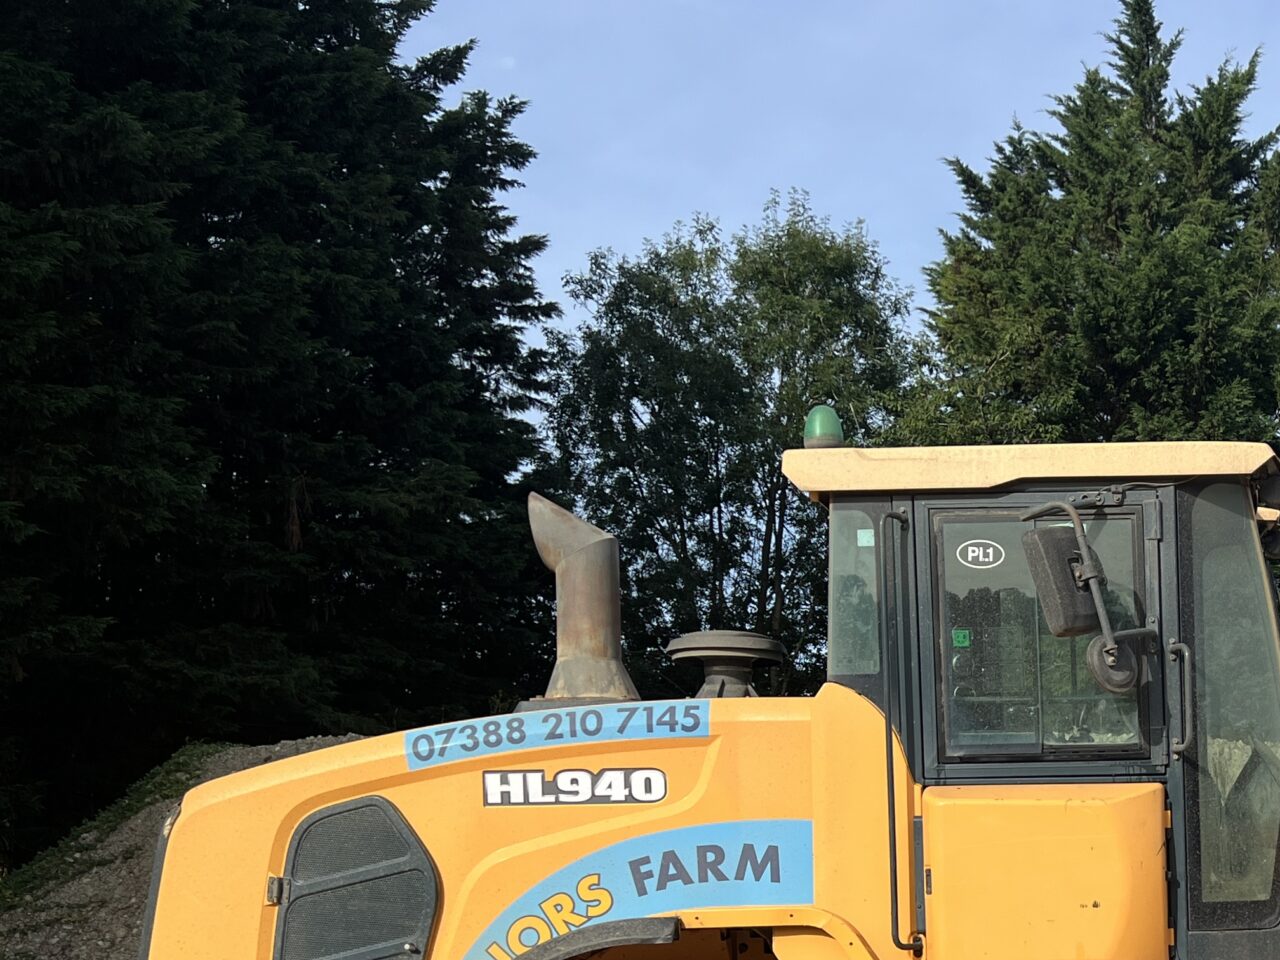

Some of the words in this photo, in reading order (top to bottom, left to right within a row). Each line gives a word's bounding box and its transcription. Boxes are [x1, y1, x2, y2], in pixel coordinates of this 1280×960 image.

[412, 717, 527, 762] 07388
[541, 709, 604, 741] 210
[616, 704, 701, 735] 7145
[484, 768, 667, 805] HL940
[627, 842, 781, 897] FARM
